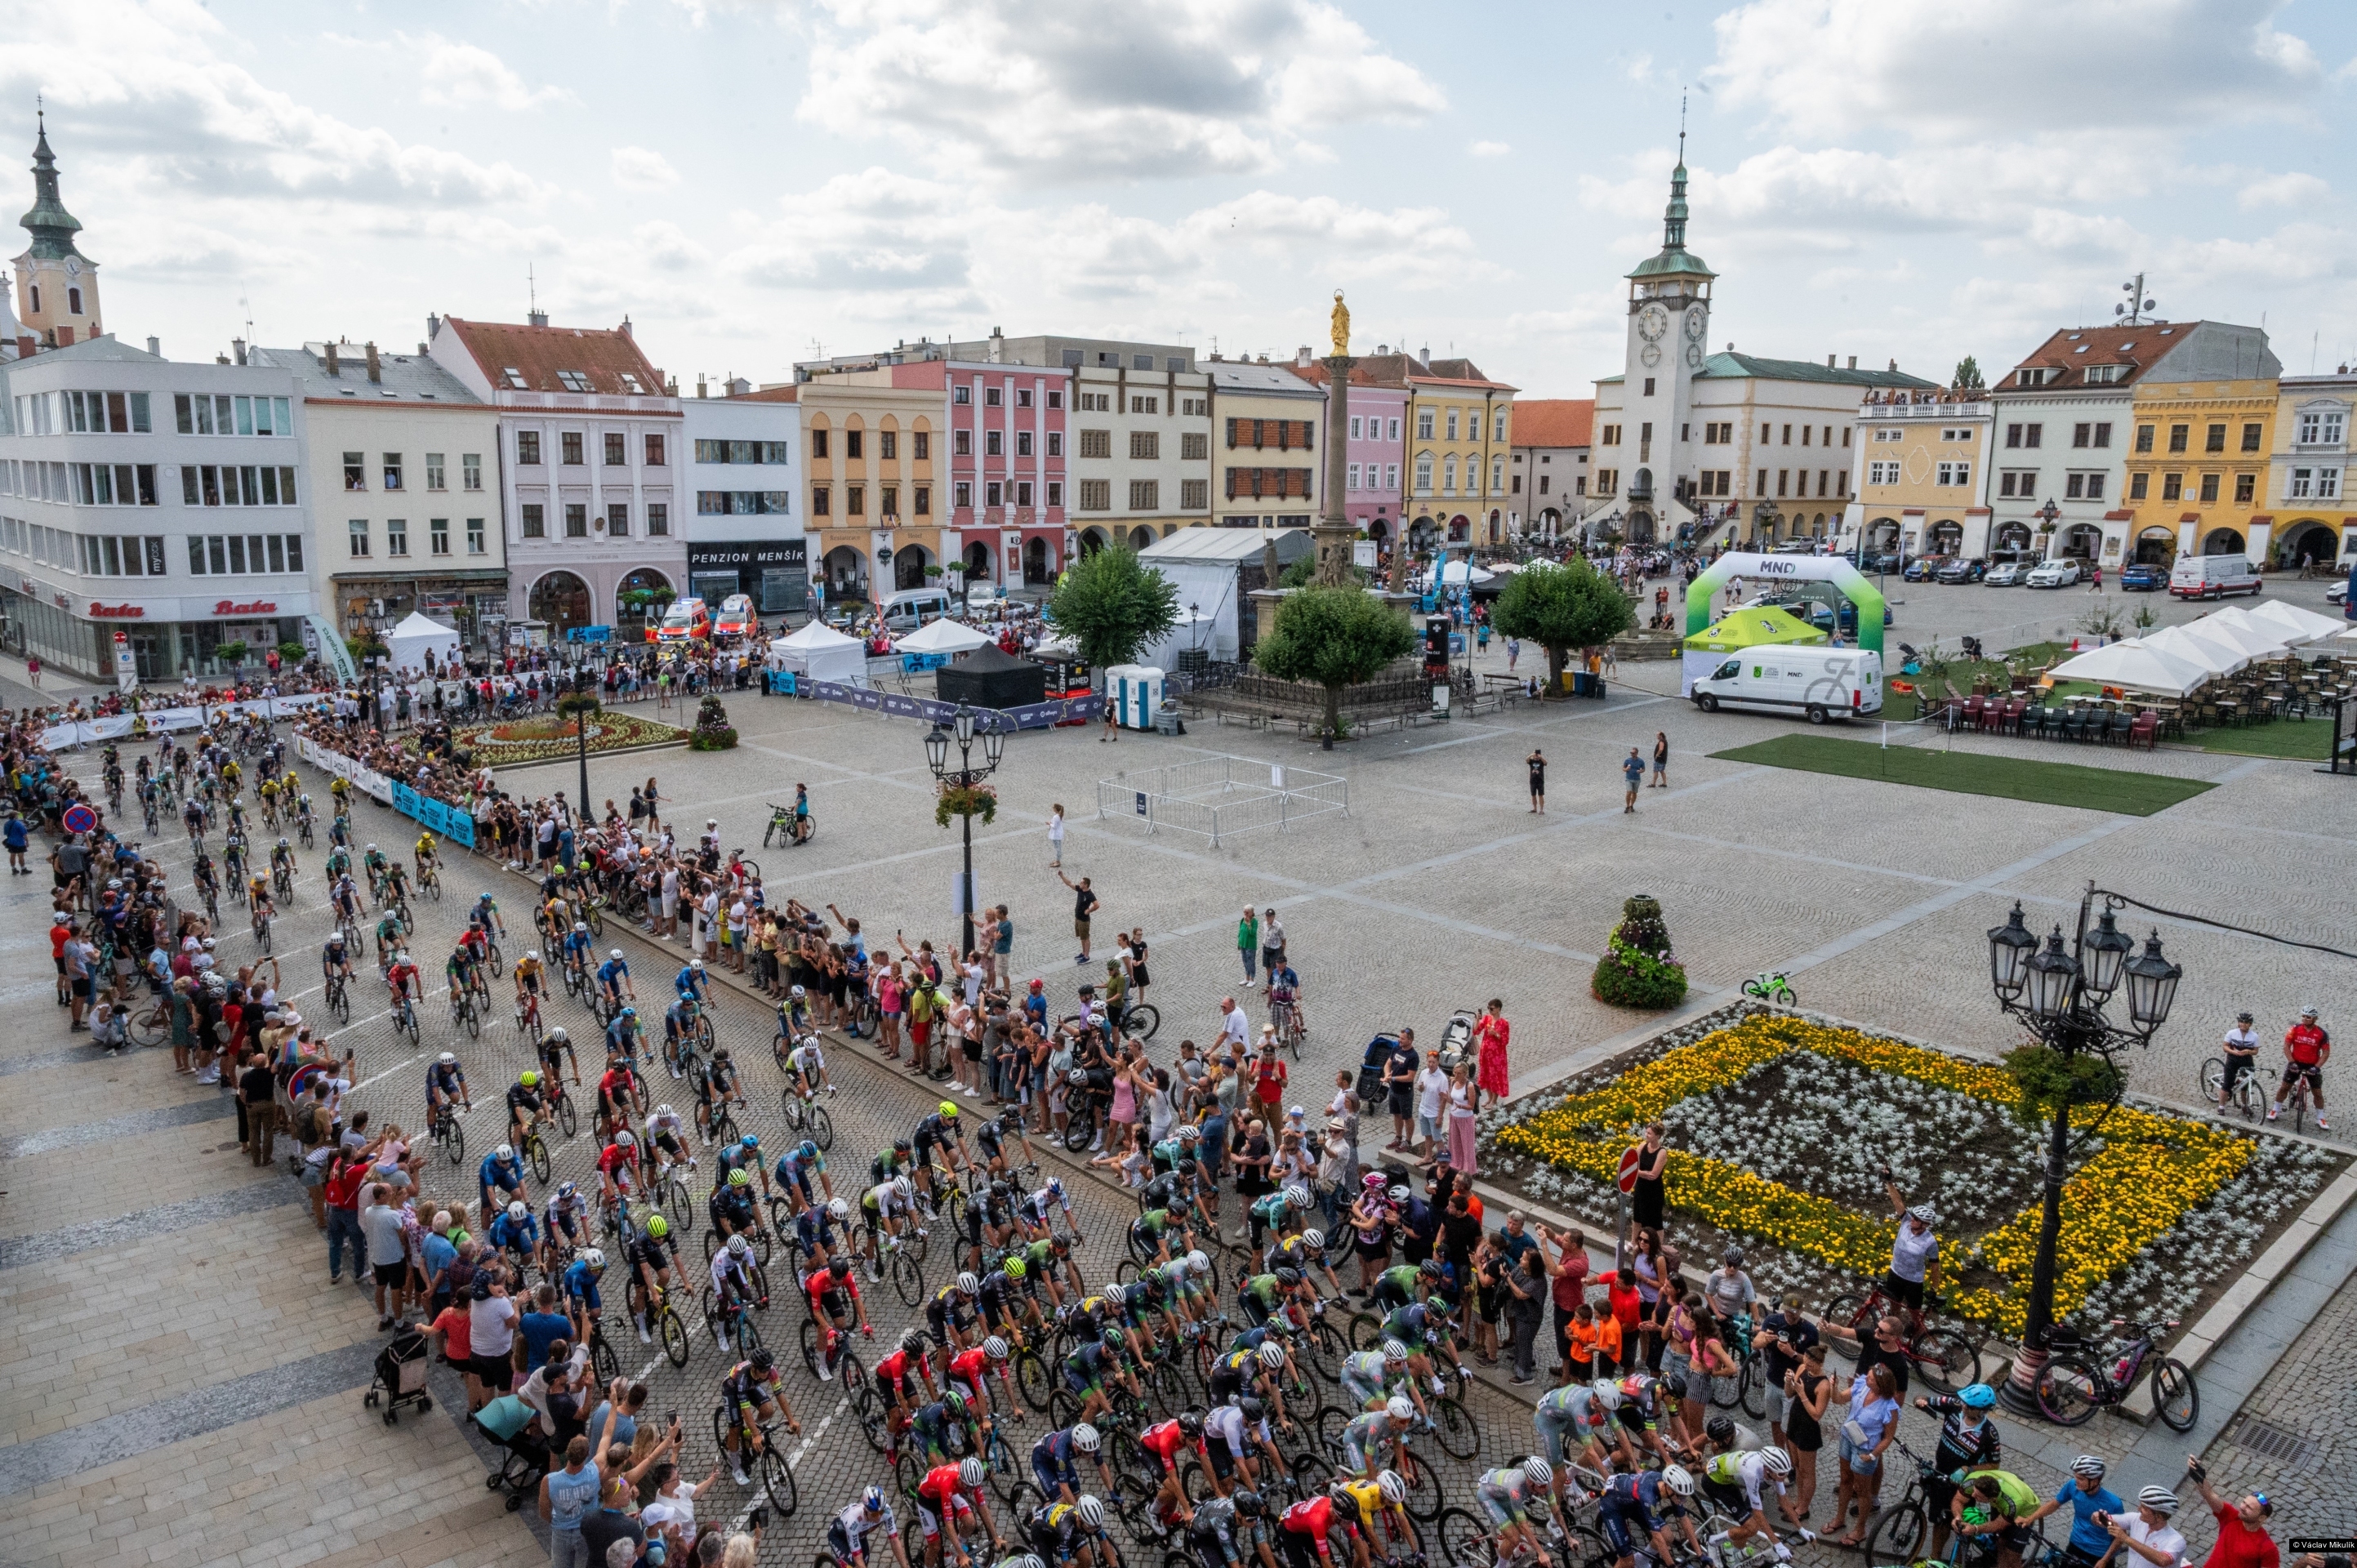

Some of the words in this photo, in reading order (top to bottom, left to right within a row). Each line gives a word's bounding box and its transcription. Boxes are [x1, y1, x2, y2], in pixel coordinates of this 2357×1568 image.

[692, 553, 749, 564] PENZION
[757, 550, 804, 561] MENŠÍK
[1760, 560, 1795, 574] MND
[1075, 676, 1089, 685] NED
